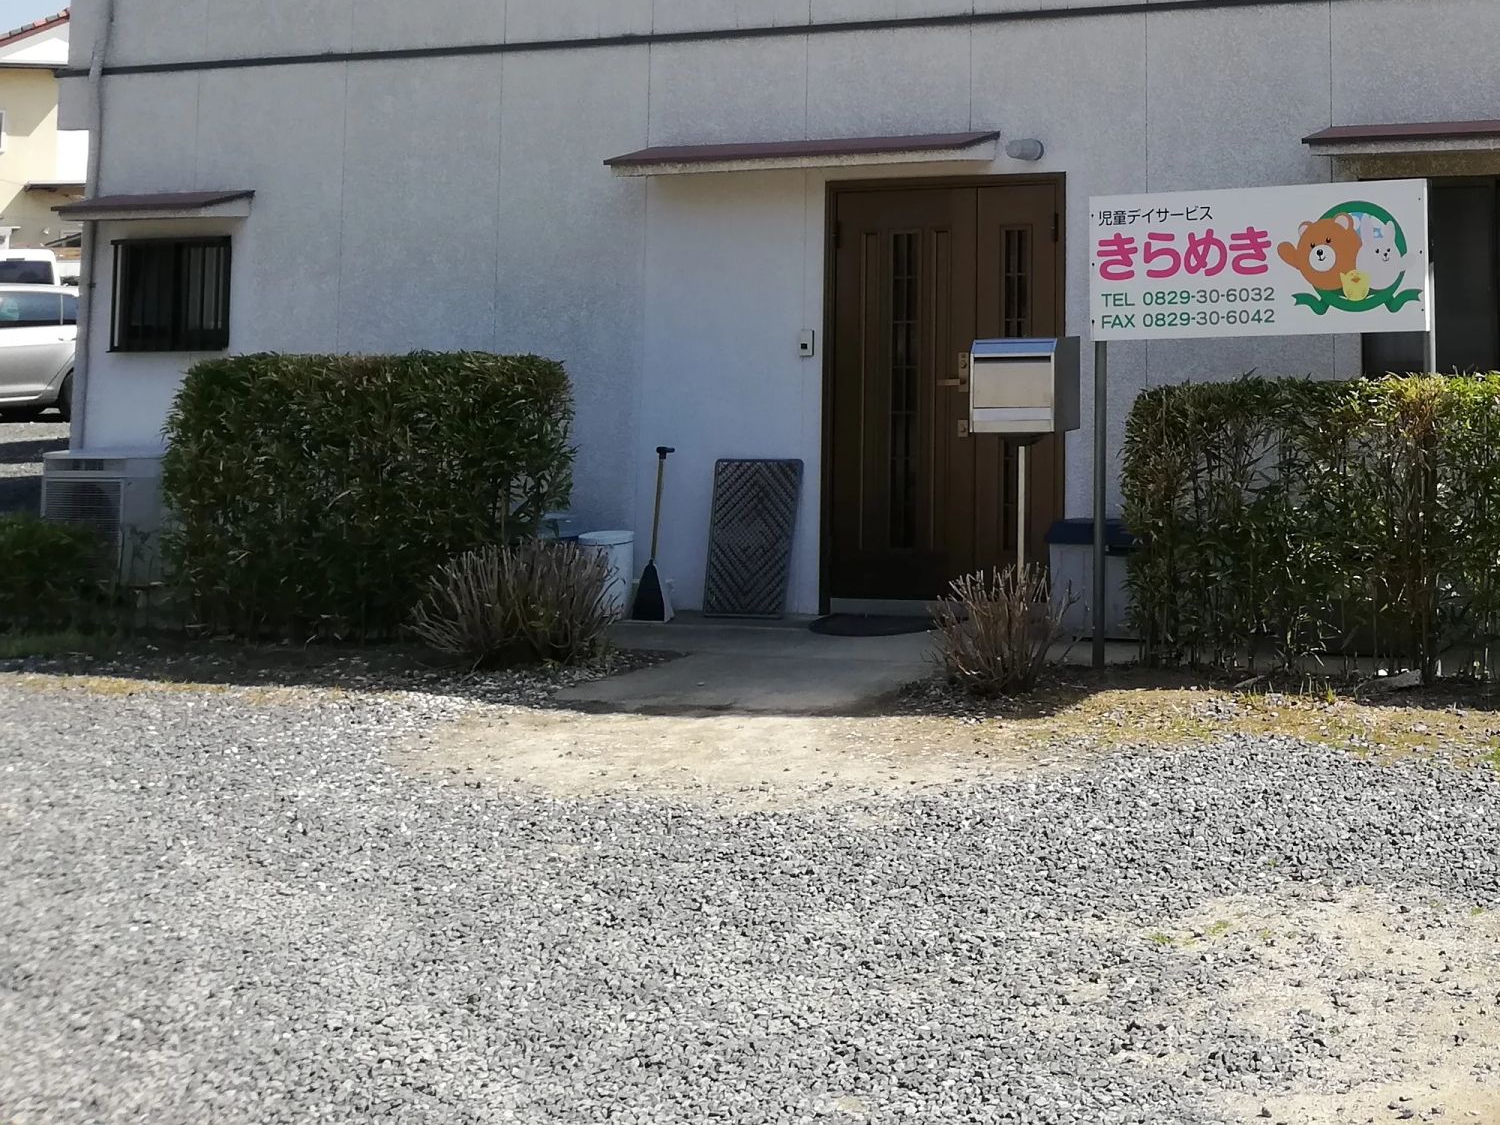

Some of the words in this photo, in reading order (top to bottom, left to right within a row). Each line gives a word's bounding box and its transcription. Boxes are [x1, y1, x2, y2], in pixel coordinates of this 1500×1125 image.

[1099, 205, 1214, 226] 児童デイサービス
[1097, 226, 1272, 281] きらめき
[1101, 292, 1136, 308] TEL
[1142, 286, 1275, 306] 0829-30-6032
[1101, 314, 1136, 329] FAX
[1142, 308, 1275, 327] 0829-30-6042
